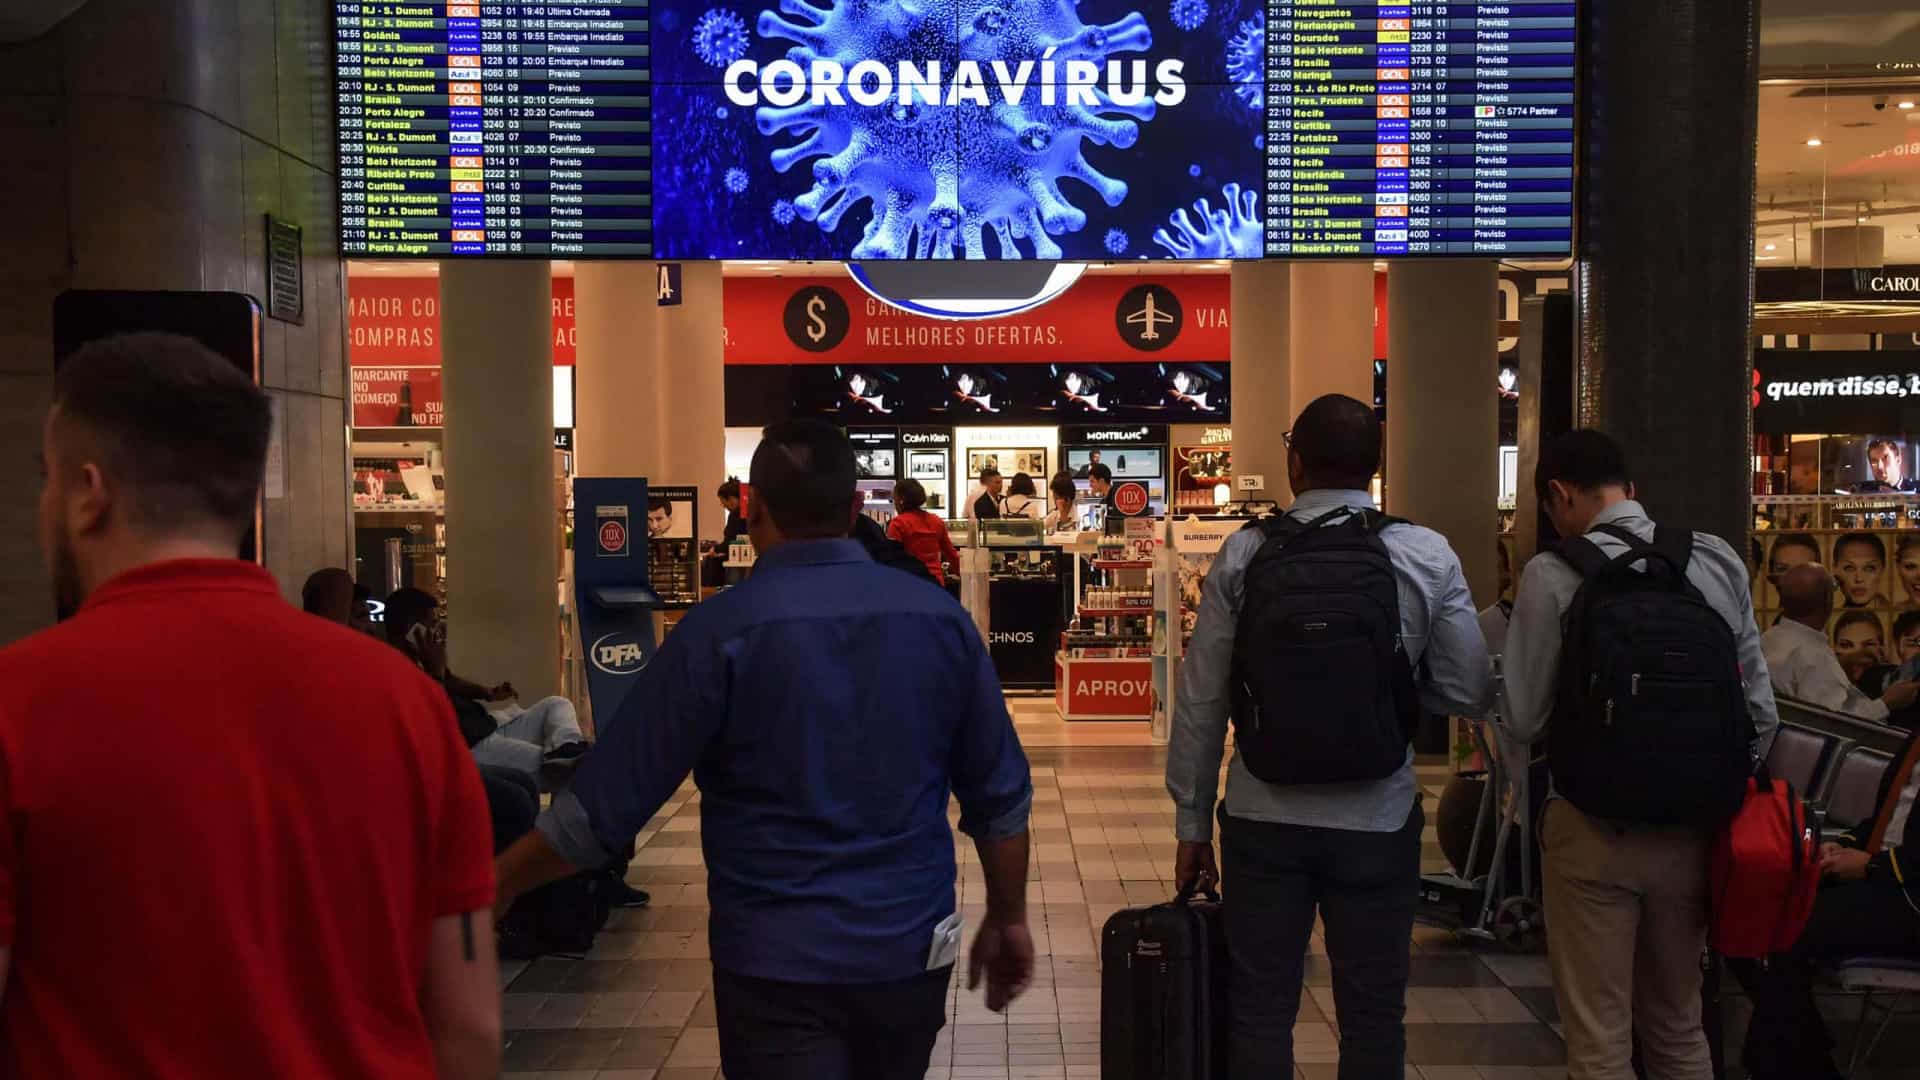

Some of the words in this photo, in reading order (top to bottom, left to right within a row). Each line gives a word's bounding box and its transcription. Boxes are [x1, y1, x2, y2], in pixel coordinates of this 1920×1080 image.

[573, 8, 610, 16] Chamada
[1294, 9, 1351, 18] Navegantes
[1477, 6, 1509, 14] Previsto
[548, 32, 588, 42] Embarque
[590, 32, 624, 40] Imediato
[1294, 34, 1339, 42] Dourados
[1477, 31, 1509, 39] Previsto
[548, 45, 580, 53] Previsto
[1477, 44, 1509, 52] Previsto
[338, 55, 360, 63] 20:00
[364, 57, 390, 65] Porto
[392, 57, 424, 66] Alegre
[548, 57, 588, 66] Embarque
[591, 57, 624, 66] Imediato
[1476, 56, 1508, 64] Previsto
[548, 70, 580, 78] Previsto
[1476, 68, 1508, 76] Previsto
[723, 46, 1187, 107] CORONAVÍRUS
[339, 82, 361, 90] 20:10
[398, 84, 435, 92] Dumont
[549, 84, 580, 92] Previsto
[1331, 84, 1347, 92] Rio
[1350, 84, 1375, 92] Preto
[1477, 82, 1509, 90] Previsto
[549, 96, 594, 104] Confirmado
[394, 109, 425, 118] Alegre
[549, 109, 594, 117] Confirmado
[549, 121, 581, 129] Previsto
[550, 134, 581, 142] Previsto
[1294, 134, 1338, 142] Fortaleza
[1476, 132, 1508, 140] Previsto
[550, 146, 595, 154] Confirmado
[1476, 144, 1508, 152] Previsto
[550, 158, 582, 166] Previsto
[1475, 156, 1507, 164] Previsto
[550, 170, 582, 178] Previsto
[1475, 168, 1507, 176] Previsto
[550, 183, 582, 191] Previsto
[1475, 181, 1507, 189] Previsto
[551, 195, 582, 203] Previsto
[1475, 206, 1506, 214] Previsto
[1474, 218, 1506, 226] Previsto
[1325, 232, 1361, 240] Dumont
[552, 244, 583, 252] Previsto
[412, 298, 440, 316] CO
[866, 326, 966, 346] MELHORES
[975, 326, 1064, 345] OFERTAS.
[354, 370, 408, 381] MARCANTE
[354, 382, 368, 392] NO
[1766, 381, 1834, 400] quem
[1838, 376, 1907, 397] disse,
[354, 393, 398, 406] COMEÇO
[412, 413, 426, 424] NO
[1086, 431, 1142, 440] MONTBLANC
[1122, 490, 1141, 504] 10X
[1184, 534, 1224, 542] BURBERRY
[600, 643, 642, 666] DFA
[1076, 680, 1152, 696] APROV
